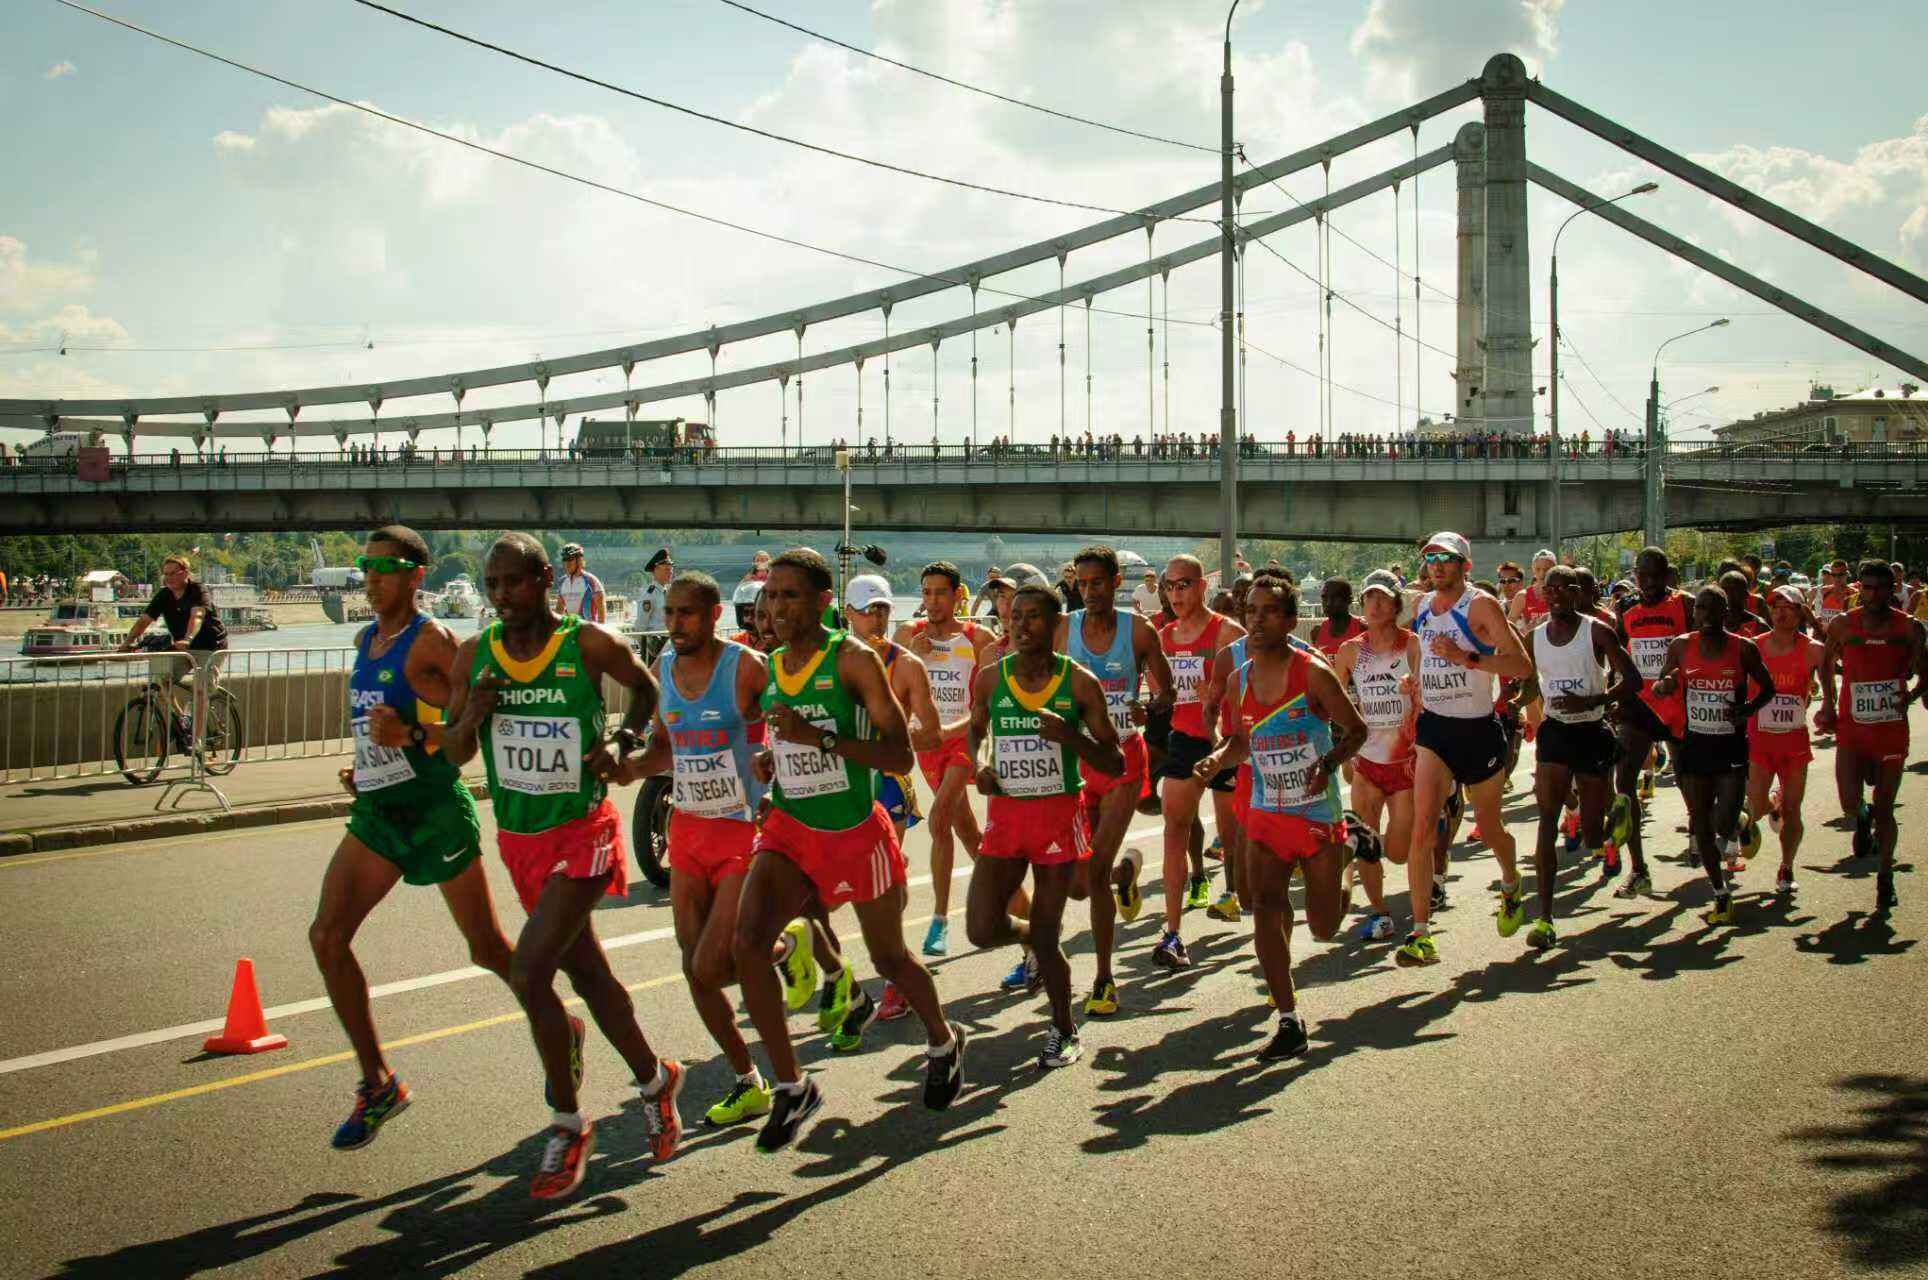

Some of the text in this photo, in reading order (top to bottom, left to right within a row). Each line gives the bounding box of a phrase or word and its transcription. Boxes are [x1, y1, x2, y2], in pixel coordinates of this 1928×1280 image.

[1641, 640, 1670, 649] TDK
[1170, 659, 1198, 669] TDK
[928, 670, 960, 680] TDK
[1422, 672, 1467, 689] MALATY
[1367, 685, 1397, 696] TDK
[1555, 679, 1583, 689] TDK
[1687, 679, 1733, 689] KENYA
[1863, 682, 1895, 693] TDK
[499, 688, 567, 705] HIOPIA
[1697, 692, 1729, 703] TDK
[1774, 696, 1800, 705] TDK
[1772, 709, 1794, 722] YIN
[1000, 716, 1044, 729] ETHIO
[515, 720, 570, 739] TDK
[1010, 738, 1053, 753] TDK
[503, 745, 569, 773] TOLA
[1266, 747, 1310, 767] TDK
[685, 755, 727, 774] TDK
[785, 751, 839, 777] TSEGAY
[1000, 758, 1060, 779] DESISA
[547, 781, 577, 791] 2013
[688, 776, 737, 803] TSEGAY
